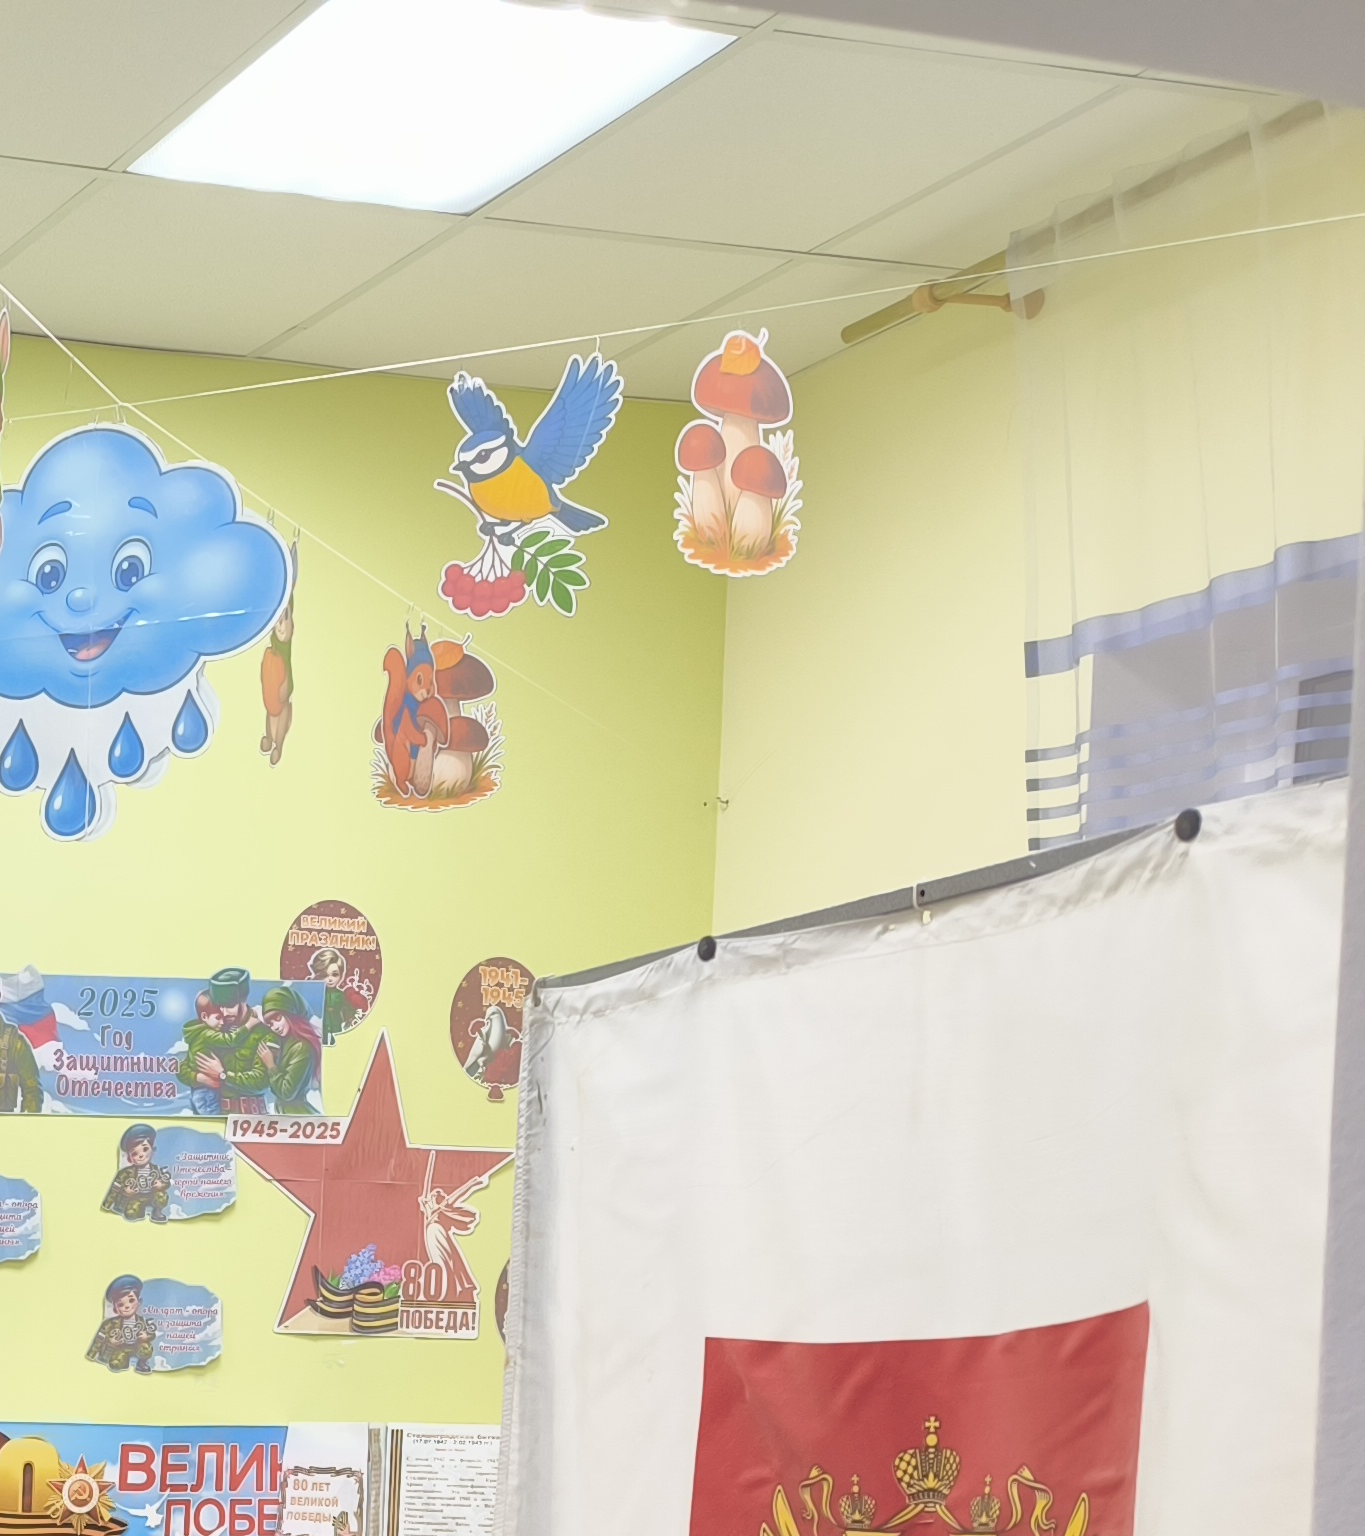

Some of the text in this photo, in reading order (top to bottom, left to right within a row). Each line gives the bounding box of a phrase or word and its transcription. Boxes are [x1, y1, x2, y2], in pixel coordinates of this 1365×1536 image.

[301, 915, 367, 932] ВЕЛИКИЙ
[289, 930, 377, 951] ПРАЗДНИК!
[479, 966, 528, 988] 1941-
[77, 987, 160, 1019] 2025
[481, 986, 526, 1008] 1945
[100, 1025, 133, 1050] Год
[53, 1048, 180, 1076] Защитника
[56, 1075, 177, 1099] Отечества
[231, 1119, 341, 1141] 1945-2025
[402, 1262, 443, 1301] 80
[400, 1309, 477, 1333] ПОБЕДА!
[293, 1479, 331, 1492] 80 ЛЕТ
[290, 1496, 339, 1507] ВЕЛИКОЙ
[286, 1511, 331, 1523] ПОБЕДЫ
